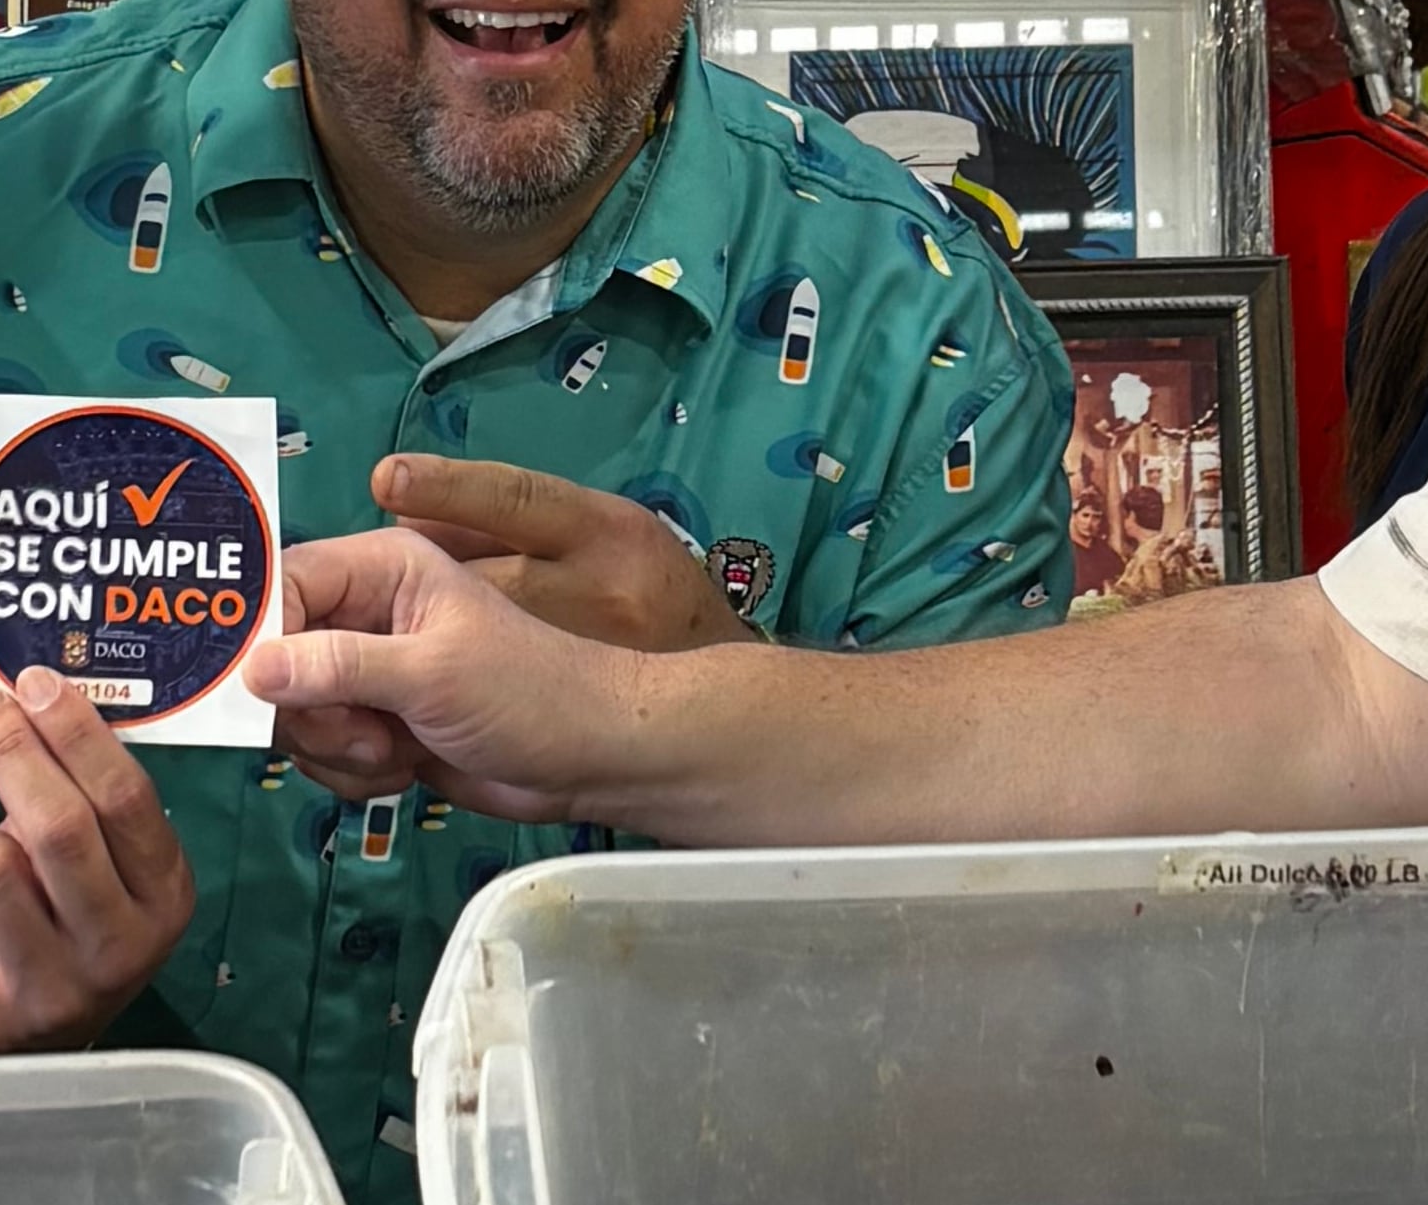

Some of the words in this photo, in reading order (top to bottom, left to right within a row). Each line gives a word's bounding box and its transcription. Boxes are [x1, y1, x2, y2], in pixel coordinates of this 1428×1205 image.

[52, 535, 243, 580] CUMPLE
[105, 585, 246, 627] DACO
[94, 641, 146, 659] DACO
[1386, 858, 1420, 885] LB
